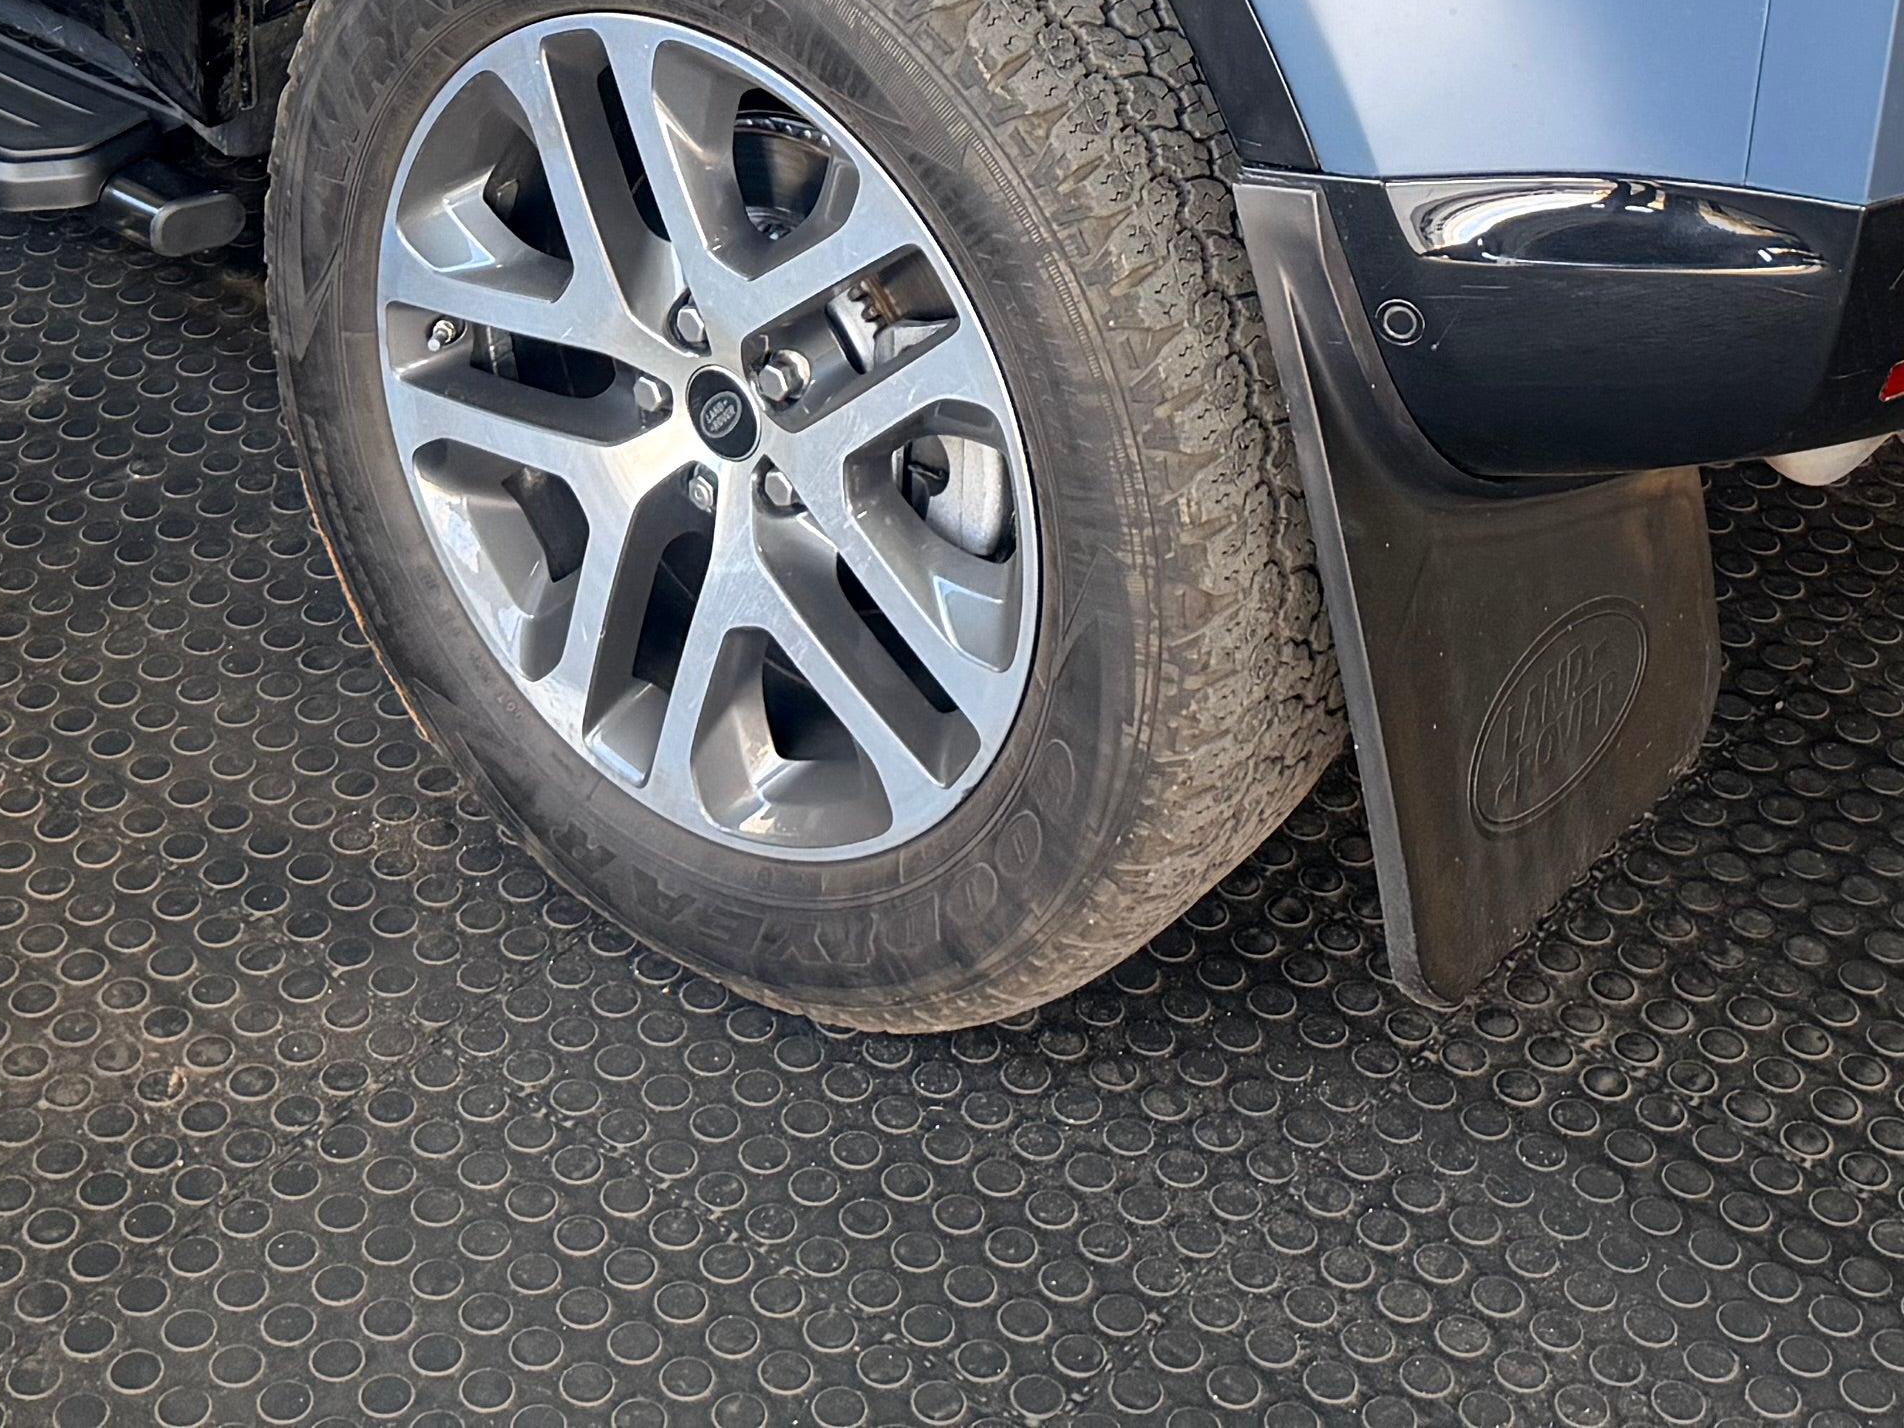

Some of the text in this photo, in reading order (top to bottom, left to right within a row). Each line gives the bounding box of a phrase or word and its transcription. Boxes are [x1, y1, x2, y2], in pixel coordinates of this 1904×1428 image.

[705, 400, 725, 424] LAND
[712, 404, 736, 431] ROVER
[548, 738, 1077, 968] GOODYEAR
